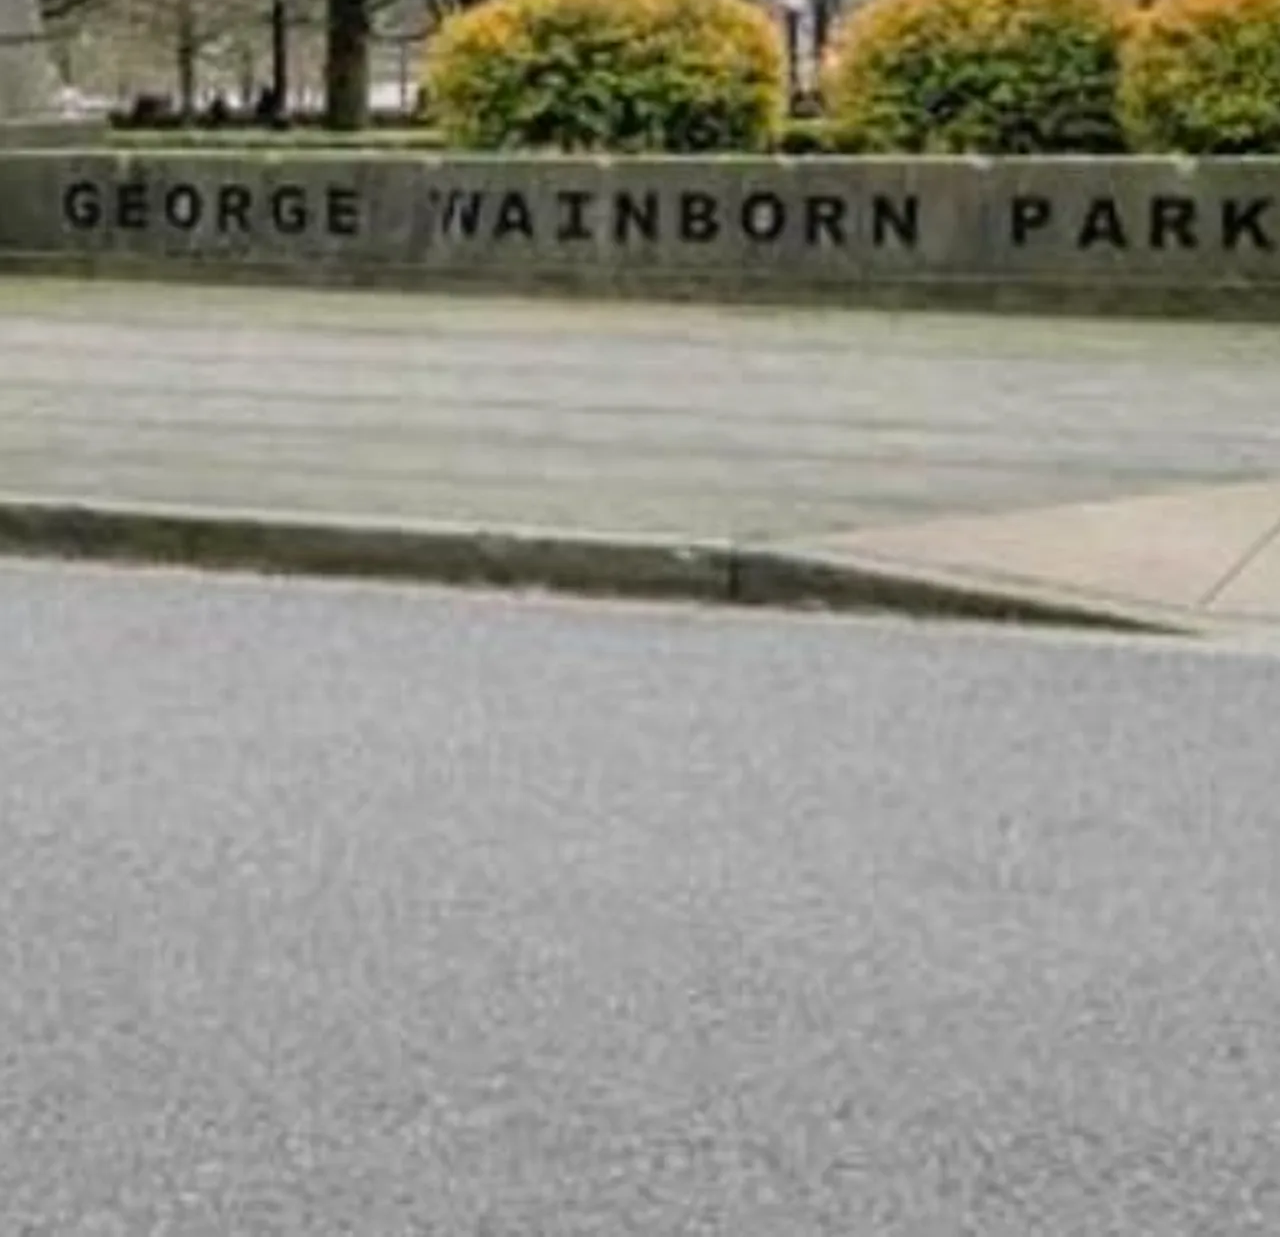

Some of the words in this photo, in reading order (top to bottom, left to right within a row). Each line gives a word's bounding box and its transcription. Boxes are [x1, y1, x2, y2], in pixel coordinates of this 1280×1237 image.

[62, 180, 362, 236] GEORGE
[426, 184, 920, 250] WAINBORN
[1010, 195, 1275, 253] PARK
